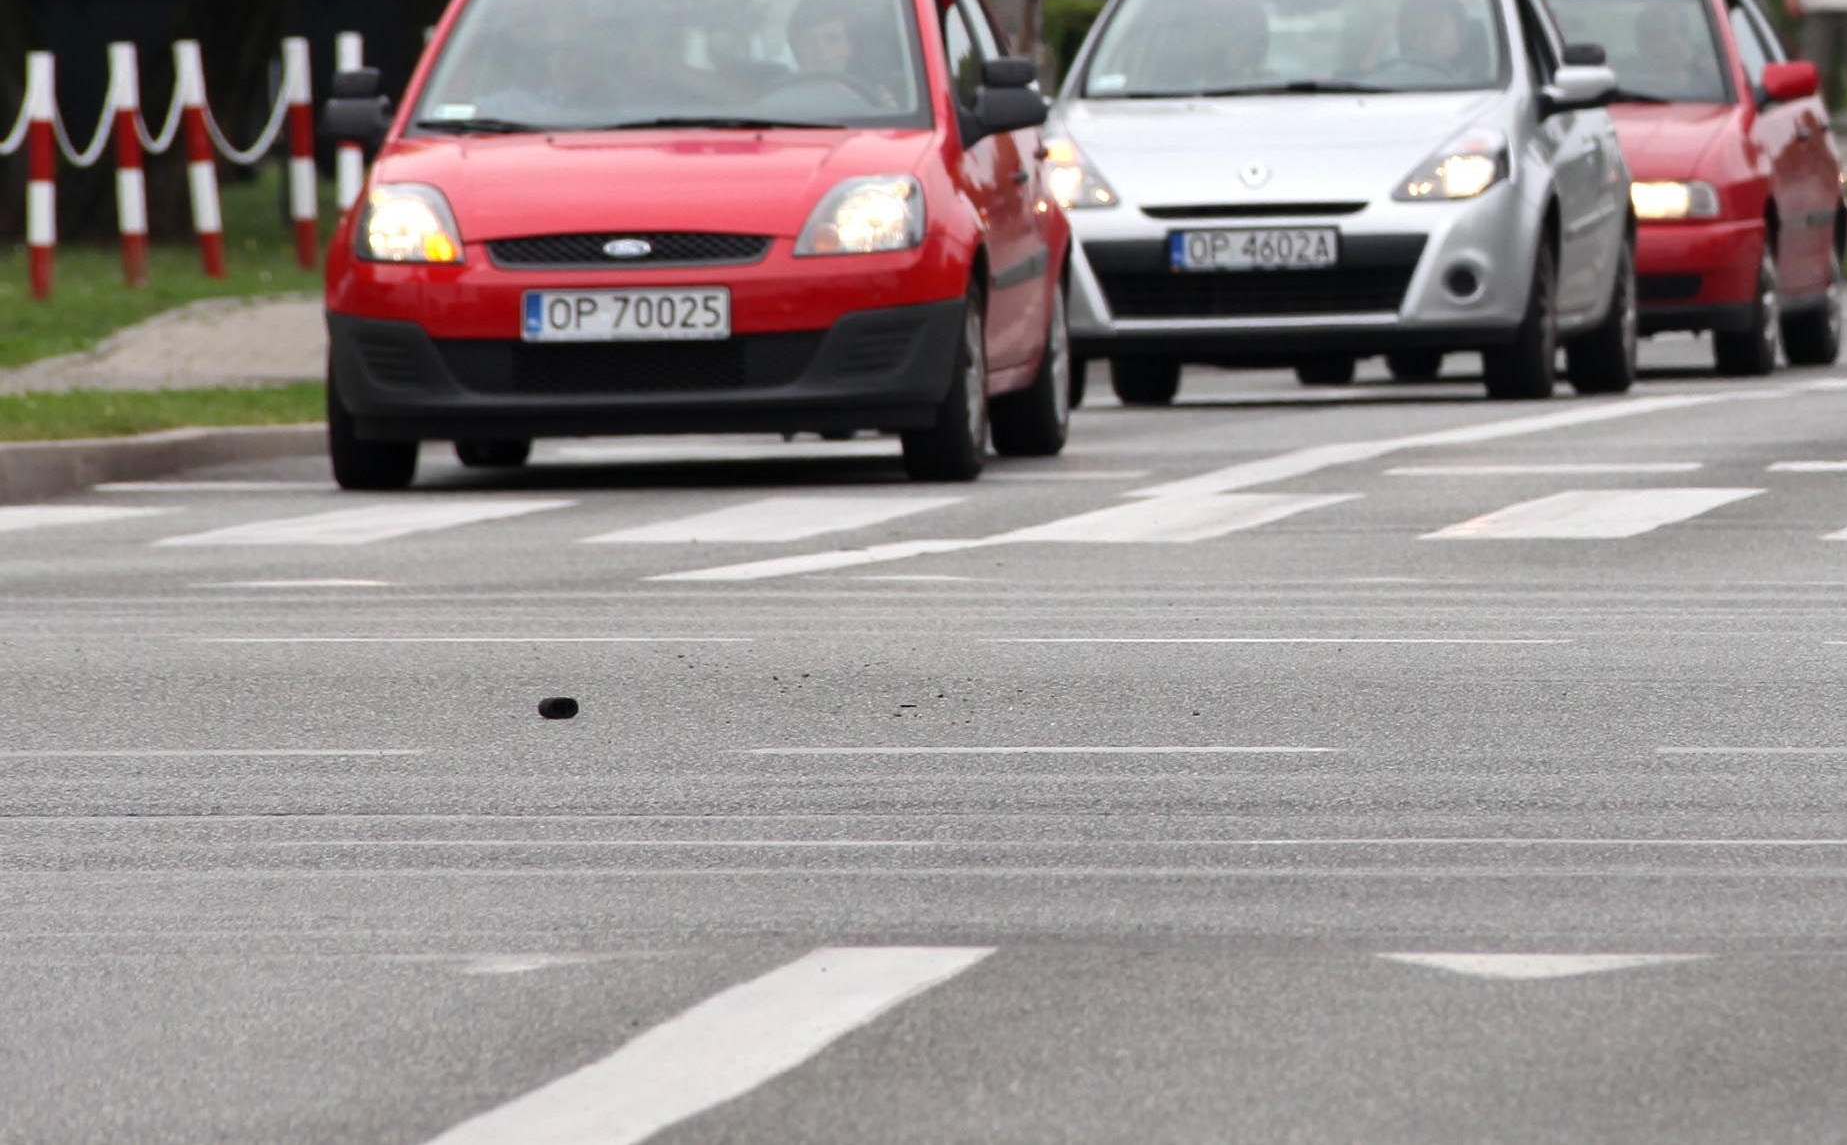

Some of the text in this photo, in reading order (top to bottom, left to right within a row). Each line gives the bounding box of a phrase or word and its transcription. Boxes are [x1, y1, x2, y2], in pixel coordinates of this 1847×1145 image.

[1189, 230, 1330, 266] OP 4602A
[549, 295, 721, 331] OP 70025
